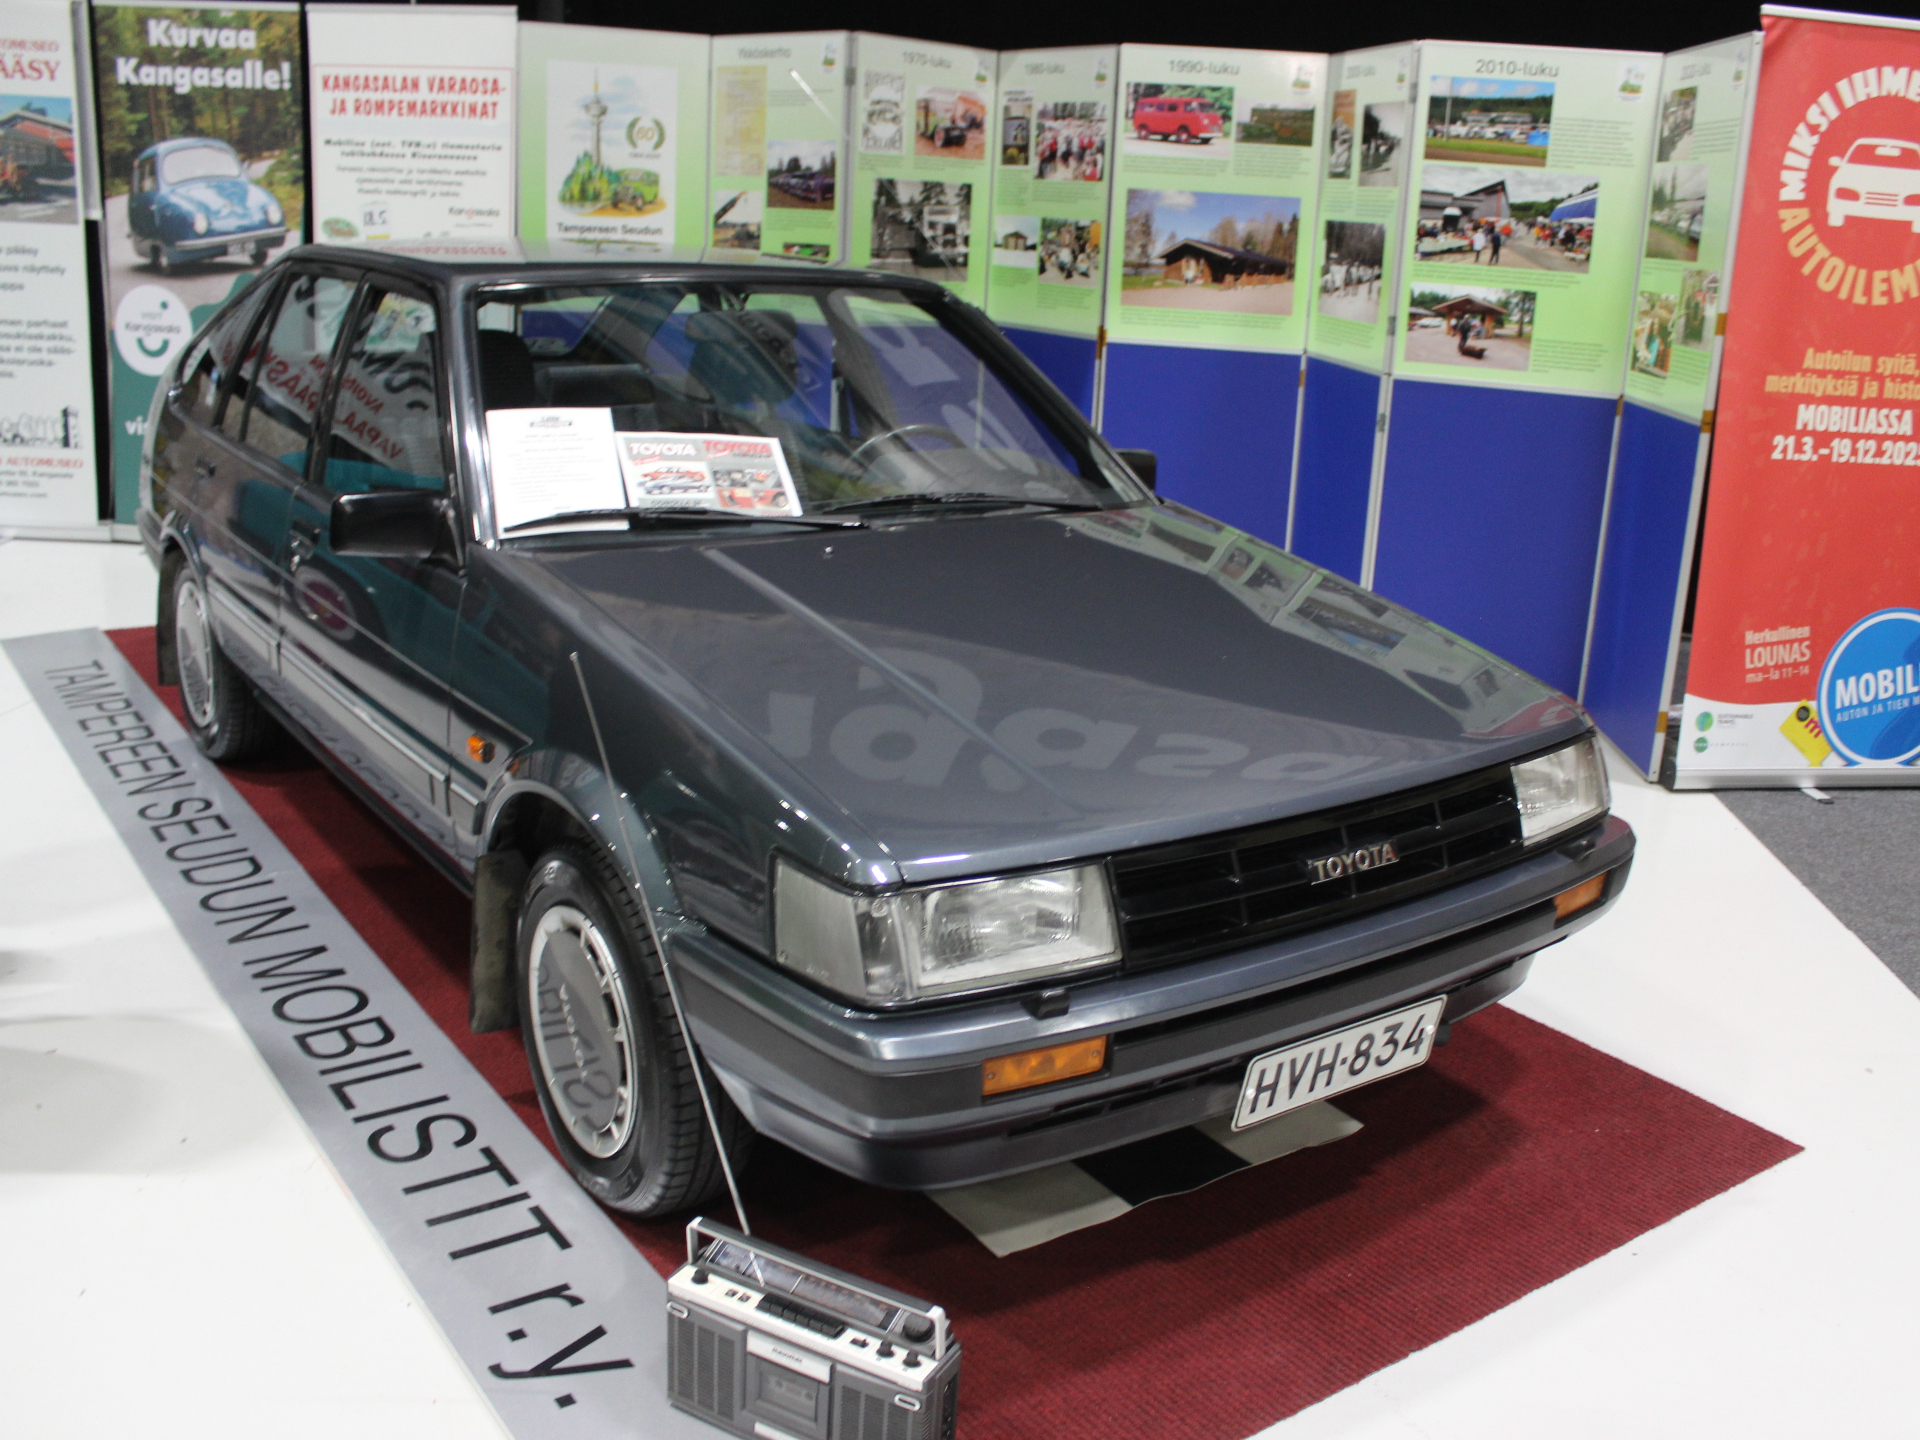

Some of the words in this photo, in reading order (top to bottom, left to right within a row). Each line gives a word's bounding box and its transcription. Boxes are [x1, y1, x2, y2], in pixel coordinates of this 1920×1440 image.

[147, 18, 257, 49] Kurvaa
[116, 56, 291, 94] Kangasalle!
[1168, 59, 1241, 75] 1990-luku
[1475, 58, 1560, 78] 2010-luku
[321, 74, 420, 94] KANGASALAN
[427, 76, 506, 96] VARAOSA-
[329, 98, 347, 116] JA
[353, 98, 499, 120] ROMPEMARKKINAT
[1779, 90, 1841, 202] MIKSI
[557, 222, 618, 236] Tampereen
[621, 223, 663, 236] Seudun
[1778, 207, 1920, 305] AUTOILEM
[1802, 347, 1873, 373] Autoilun
[1764, 372, 1859, 397] merkityksiä
[1861, 376, 1879, 400] ja
[1795, 403, 1913, 437] MOBILIASSA
[629, 442, 698, 456] TOYOTA
[703, 440, 773, 455] TOYOTA
[1770, 434, 1920, 466] 21.3.-19.12.202
[1744, 625, 1811, 646] Herkullinen
[1744, 640, 1811, 669] LOUNAS
[1834, 662, 1920, 709] MOBIL
[1836, 706, 1870, 723] AUTON
[1871, 703, 1884, 716] JA
[1312, 842, 1398, 881] TOYOTA
[45, 659, 194, 798] TAMPEREEN
[137, 795, 311, 946] SEUDUN
[243, 944, 573, 1262] MOBILISTIT
[487, 1282, 634, 1410] r.y.
